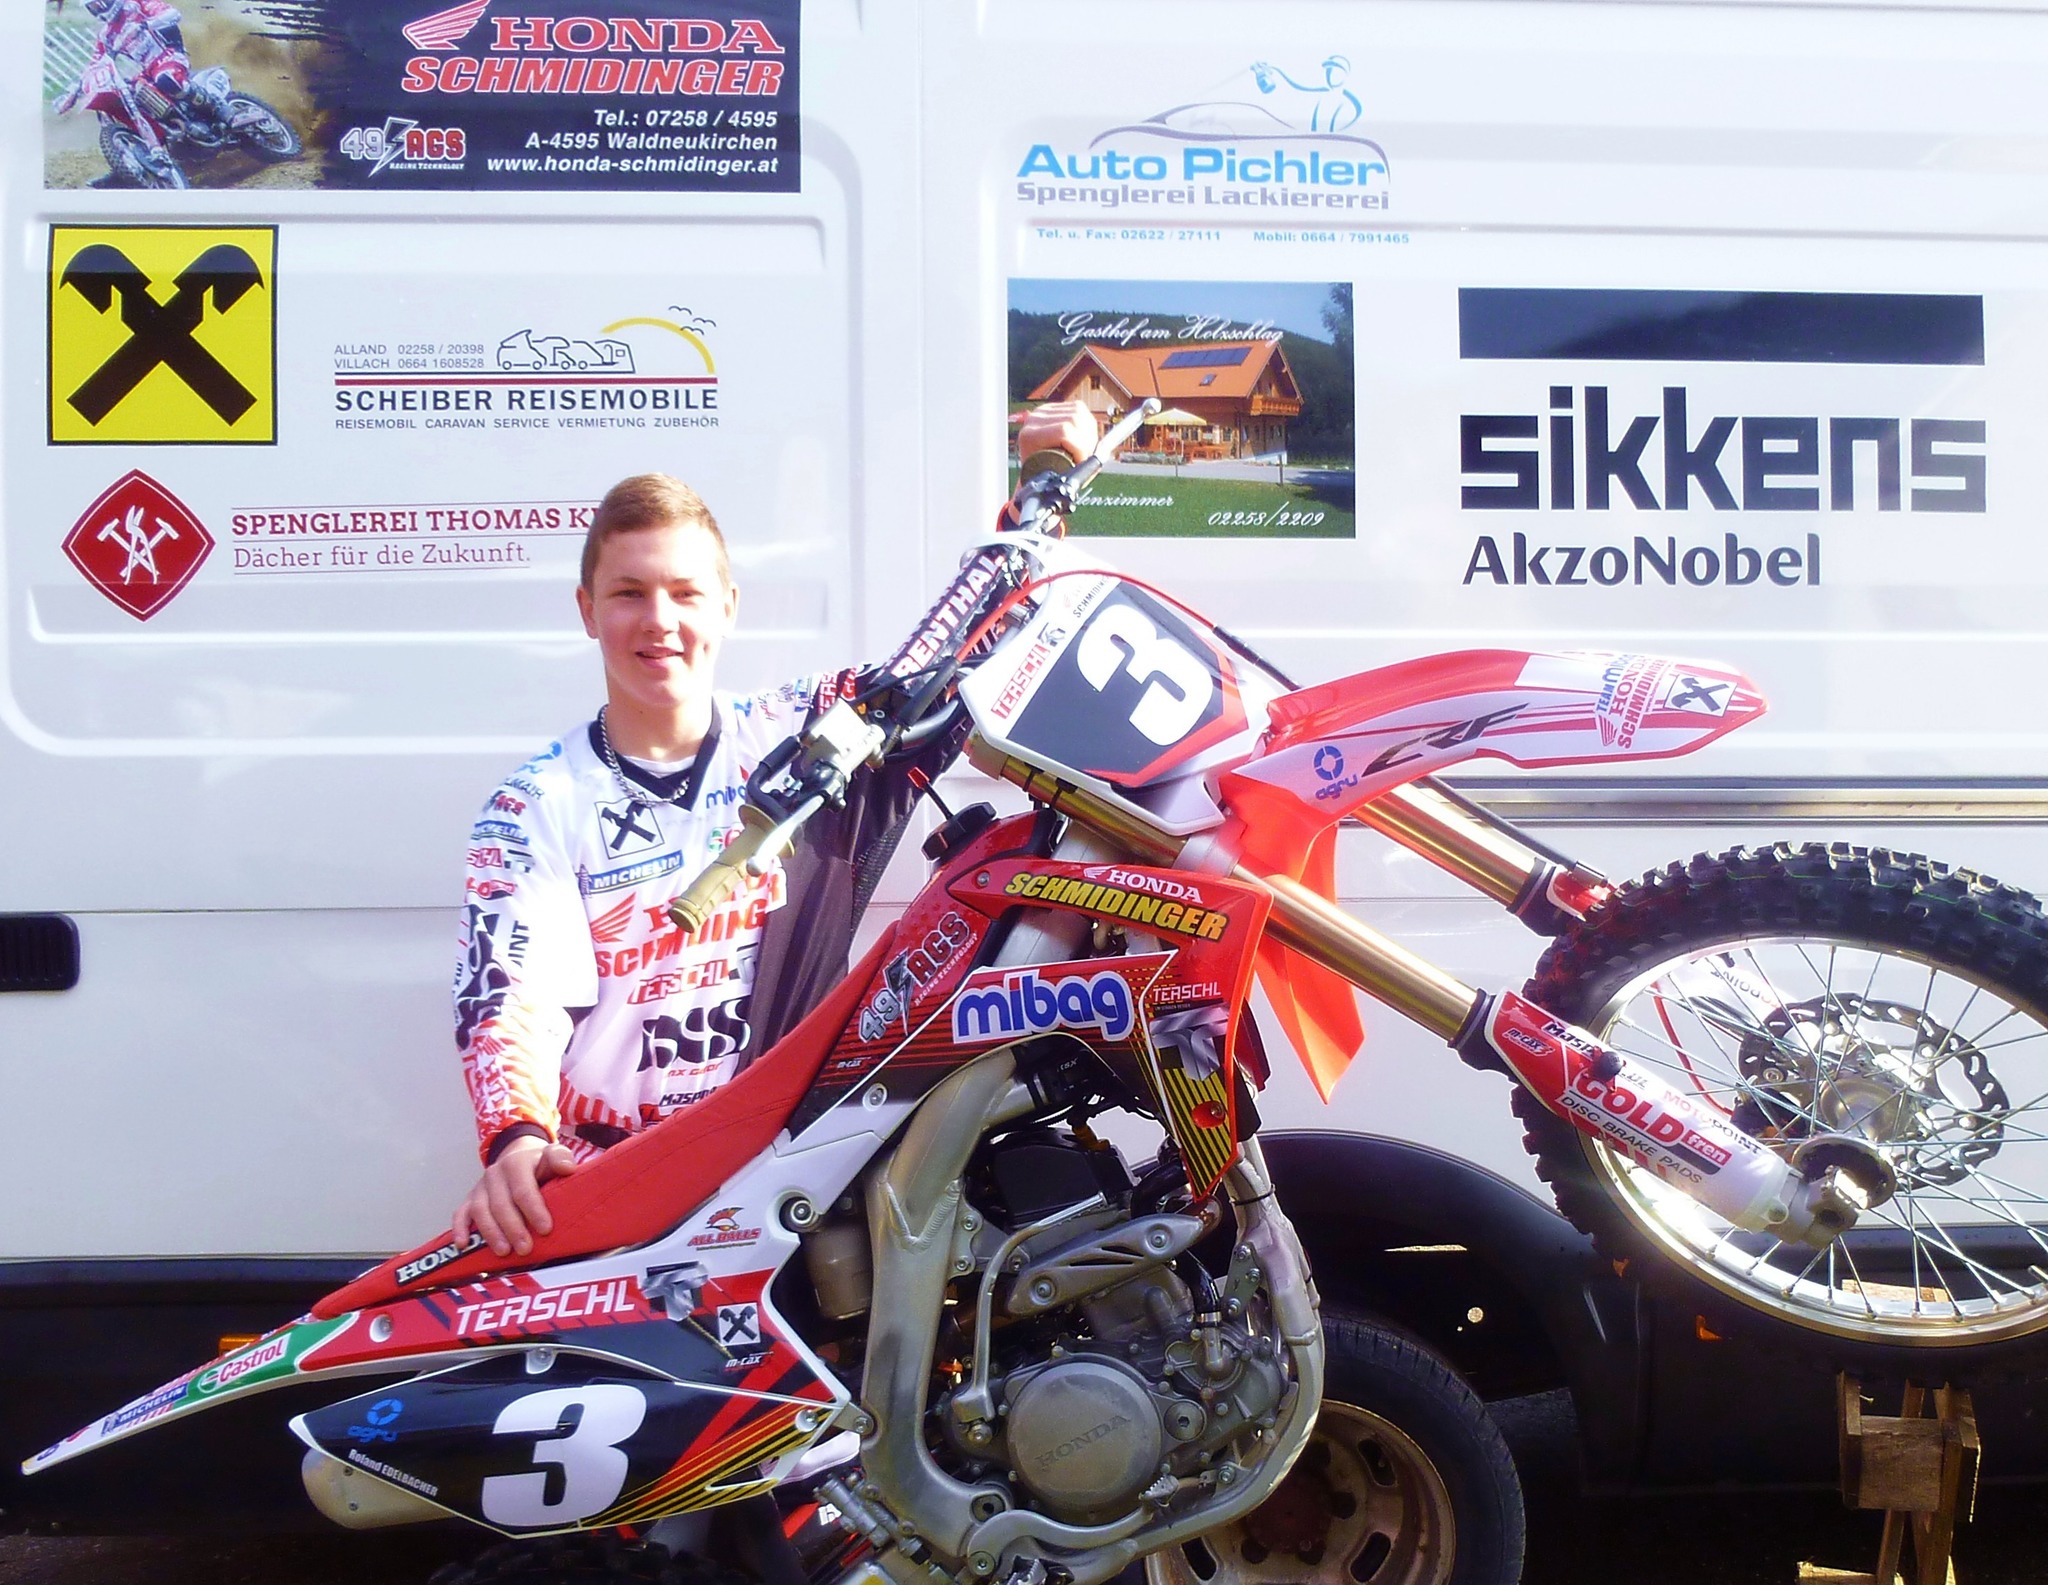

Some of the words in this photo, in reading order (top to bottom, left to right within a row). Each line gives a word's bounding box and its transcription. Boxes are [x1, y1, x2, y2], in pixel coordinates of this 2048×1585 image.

[490, 17, 785, 54] HONDA
[401, 57, 785, 96] SCHMIDINGER
[594, 109, 639, 127] Tel.:
[646, 110, 708, 127] 07258
[728, 110, 778, 127] 4595
[340, 127, 385, 159] 49
[404, 128, 466, 160] AGS
[525, 132, 599, 149] A-4595
[607, 133, 778, 150] Waldneukirchen
[487, 156, 778, 176] www.honda-schmidinger.at
[1016, 144, 1167, 181] Auto
[1182, 148, 1386, 186] Pichler
[1016, 182, 1195, 208] Spenglerei
[1204, 186, 1390, 210] Lackiererei
[1037, 228, 1063, 239] Tel.
[1086, 229, 1116, 240] Fax:
[1121, 230, 1165, 241] 02622
[1178, 230, 1221, 241] 27111
[1253, 231, 1296, 242] Mobil:
[1301, 232, 1336, 243] 0664
[1350, 233, 1410, 244] 7991465
[1058, 312, 1150, 346] Gasthof
[1140, 328, 1171, 340] am
[1178, 314, 1284, 348] Holzschlag
[334, 344, 387, 355] ALLAND
[397, 344, 436, 355] 02258
[447, 344, 485, 355] 20398
[334, 358, 390, 369] VILLACH
[397, 358, 428, 369] 0664
[432, 358, 485, 369] 1608528
[335, 390, 493, 412] SCHEIBER
[507, 389, 718, 411] REISEMOBILE
[335, 419, 417, 430] REISEMOBIL
[425, 418, 486, 429] CARAVAN
[493, 418, 550, 429] SERVICE
[558, 417, 646, 428] VERMIETUNG
[653, 415, 720, 428] ZUBEHÖR
[1460, 386, 1987, 513] sikkens
[231, 511, 418, 536] SPENGLEREI
[426, 507, 561, 533] THOMAS
[1207, 501, 1326, 528] 02258/2209
[234, 545, 323, 568] Dächer
[331, 544, 369, 567] für
[376, 543, 414, 566] die
[422, 541, 531, 564] Zukunft.
[1462, 531, 1821, 586] AkzoNobel
[1076, 603, 1214, 747] 3
[593, 853, 682, 888] MICHELIN
[1107, 868, 1203, 904] HONDA
[1004, 872, 1230, 941] SCHMIDINGER
[859, 987, 902, 1043] 49
[906, 911, 970, 988] AGS
[954, 970, 1134, 1043] mibag
[1575, 1073, 1685, 1144] GOLD
[1687, 1133, 1727, 1163] fren
[1561, 1096, 1600, 1123] DISC
[1602, 1122, 1655, 1157] BRAKE
[1658, 1155, 1703, 1184] PADS
[396, 1230, 486, 1284] HOND
[219, 1339, 283, 1383] Castrol
[119, 1386, 185, 1423] MICHELIN
[481, 1384, 647, 1527] 3
[1035, 1412, 1131, 1469] HONDA
[348, 1448, 383, 1472] Roland
[381, 1464, 439, 1497] EDELBACHER
